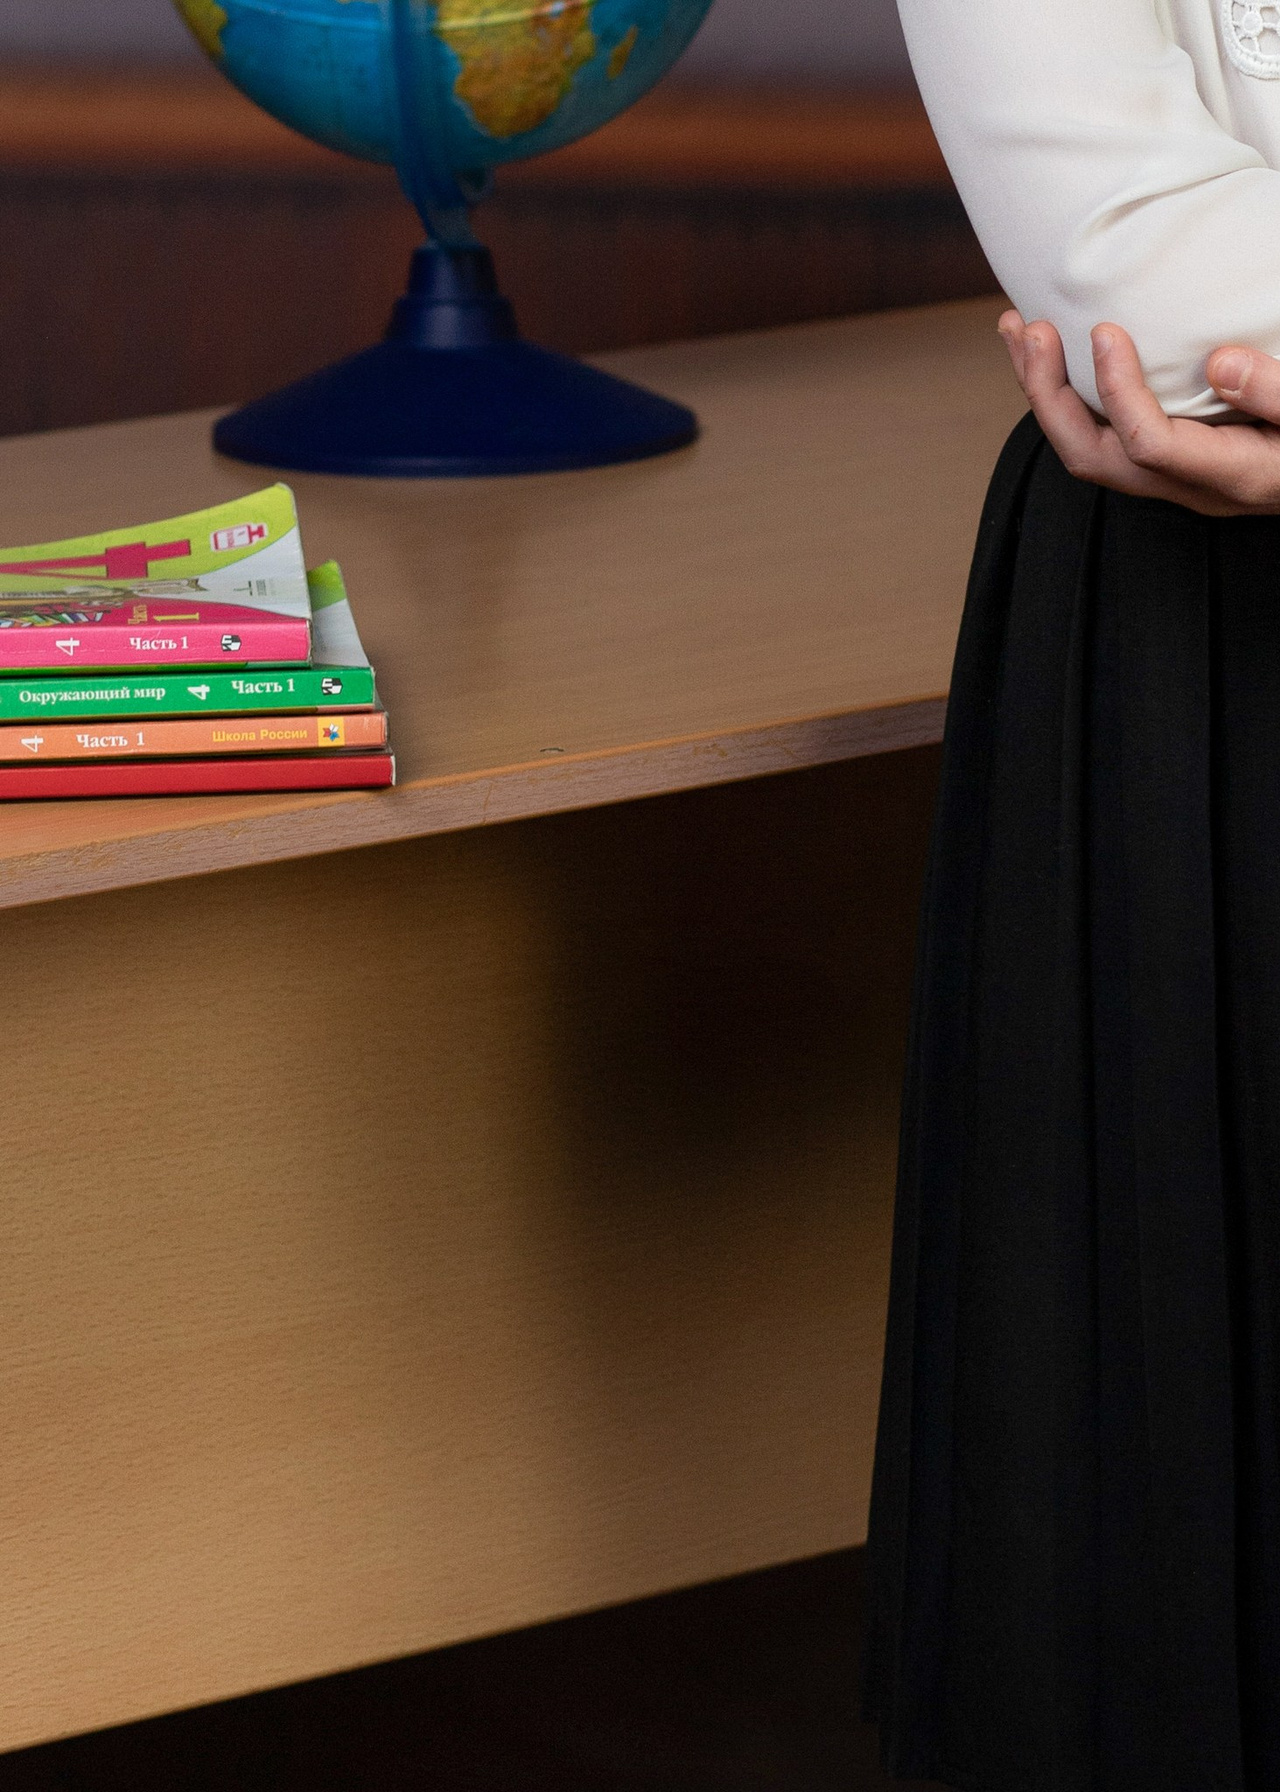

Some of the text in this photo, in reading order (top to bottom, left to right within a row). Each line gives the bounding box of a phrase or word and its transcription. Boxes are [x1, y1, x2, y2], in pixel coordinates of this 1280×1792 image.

[55, 636, 189, 656] 4 Часть 1
[19, 678, 295, 705] Окружающий мир 4 Часть 1
[20, 728, 308, 753] 4 Часть 1 Школа России
